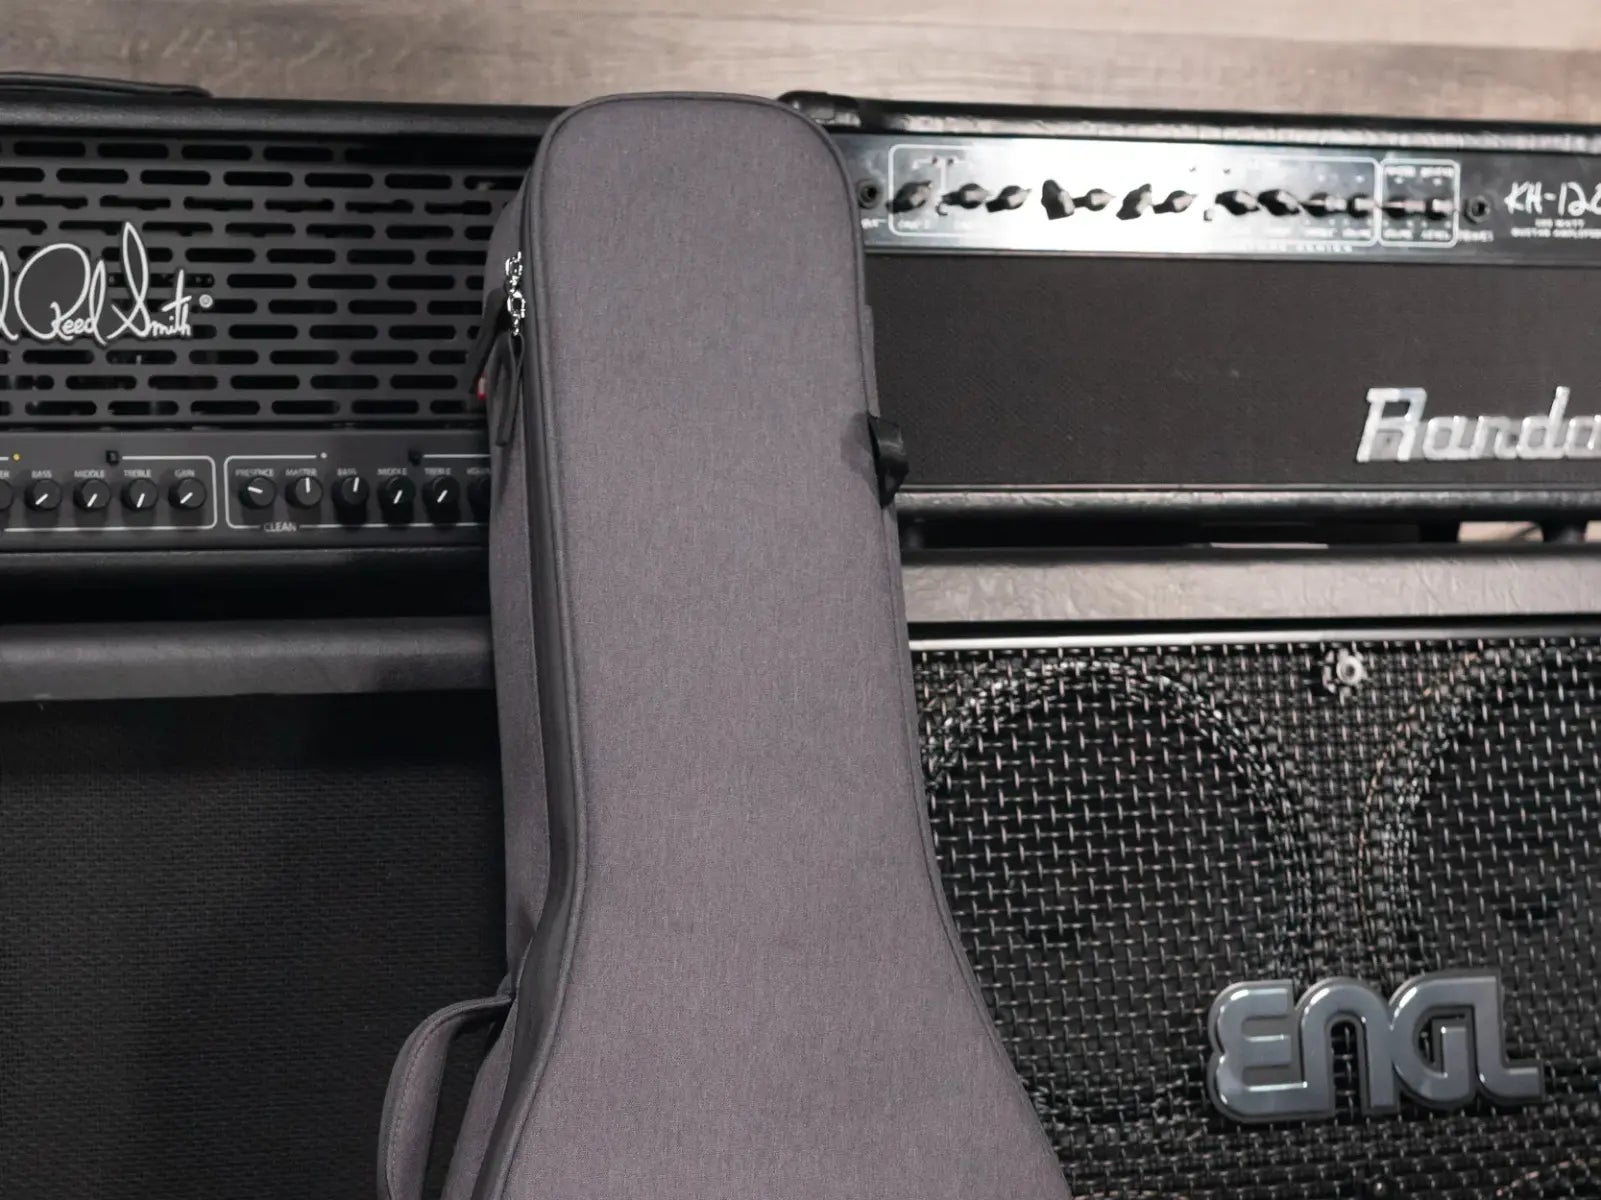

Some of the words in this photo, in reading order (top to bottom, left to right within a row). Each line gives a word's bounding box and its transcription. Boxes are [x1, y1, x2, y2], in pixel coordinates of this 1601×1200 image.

[31, 469, 53, 479] BASS
[74, 469, 105, 479] MIDDLE
[123, 469, 152, 478] TREBLE
[264, 522, 297, 533] CLEAN
[1209, 972, 1544, 1121] ENGL
